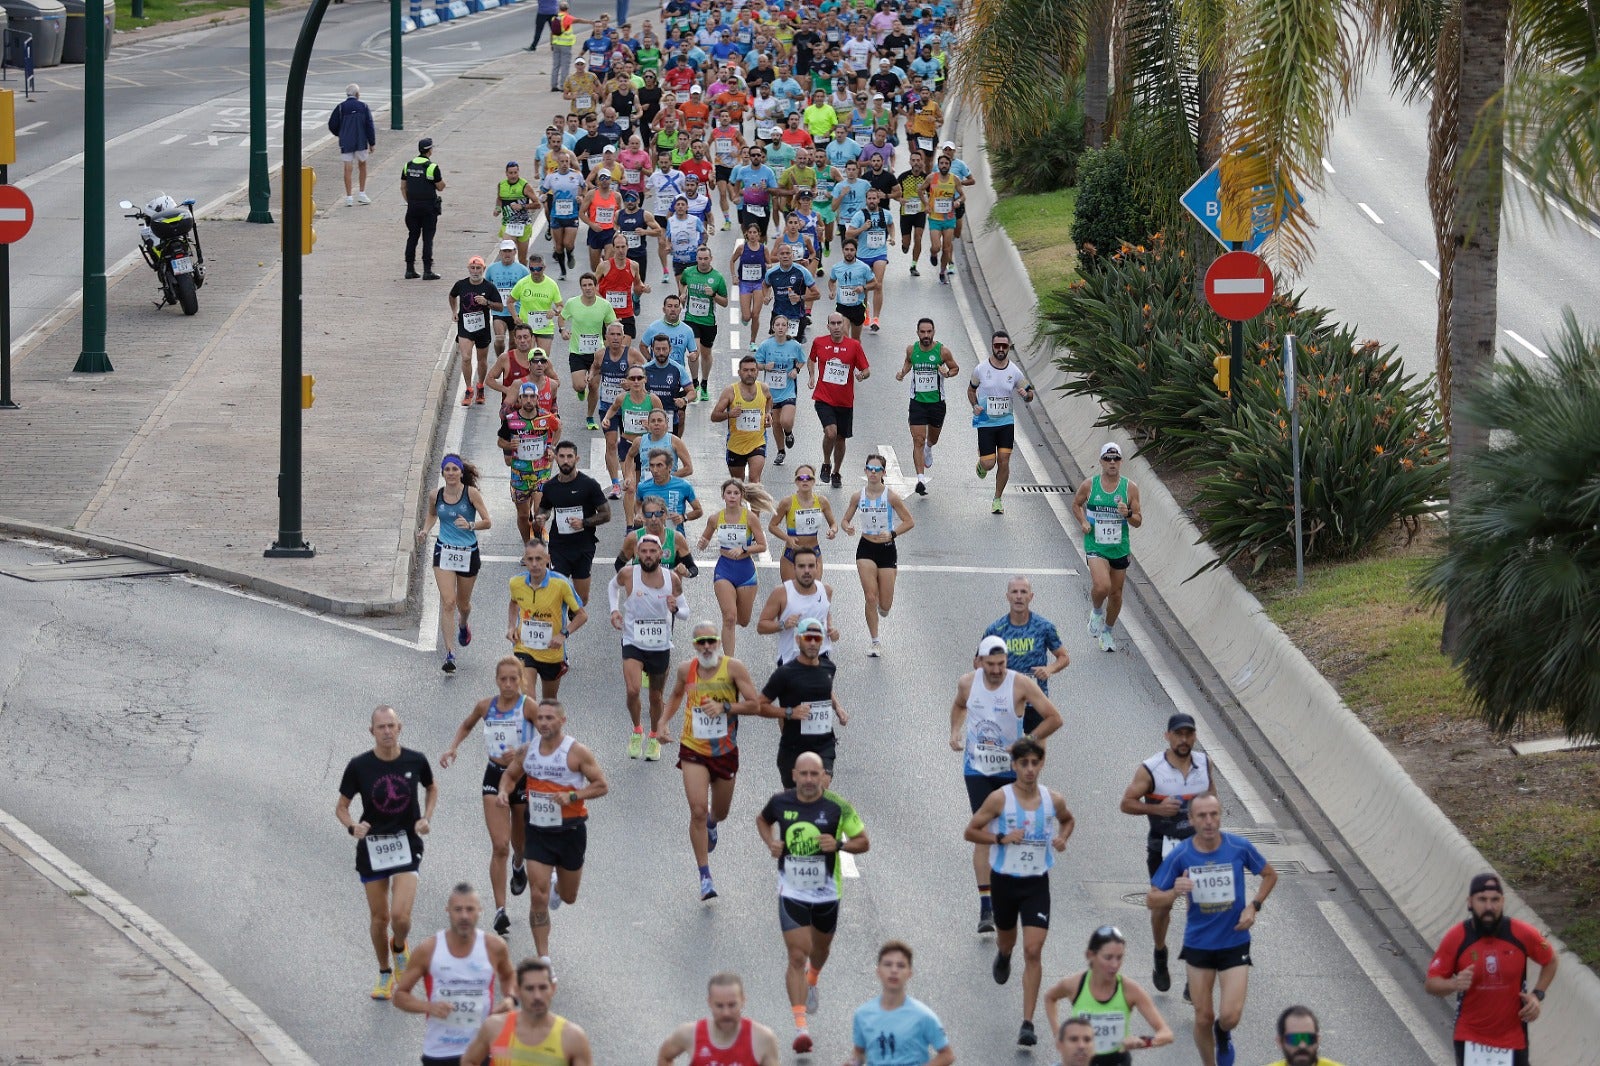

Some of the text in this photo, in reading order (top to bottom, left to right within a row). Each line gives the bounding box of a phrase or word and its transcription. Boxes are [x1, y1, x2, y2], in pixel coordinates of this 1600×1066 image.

[448, 554, 464, 562] 263
[528, 630, 545, 639] 196
[640, 627, 662, 635] 6189
[1006, 638, 1035, 651] ARMY
[699, 716, 722, 725] 1072
[494, 732, 506, 741] 26
[533, 802, 555, 813] 9959
[376, 841, 403, 854] 9989
[1021, 852, 1034, 861] 25
[793, 867, 819, 876] 1440
[1196, 876, 1230, 888] 11053
[1094, 1026, 1116, 1036] 281
